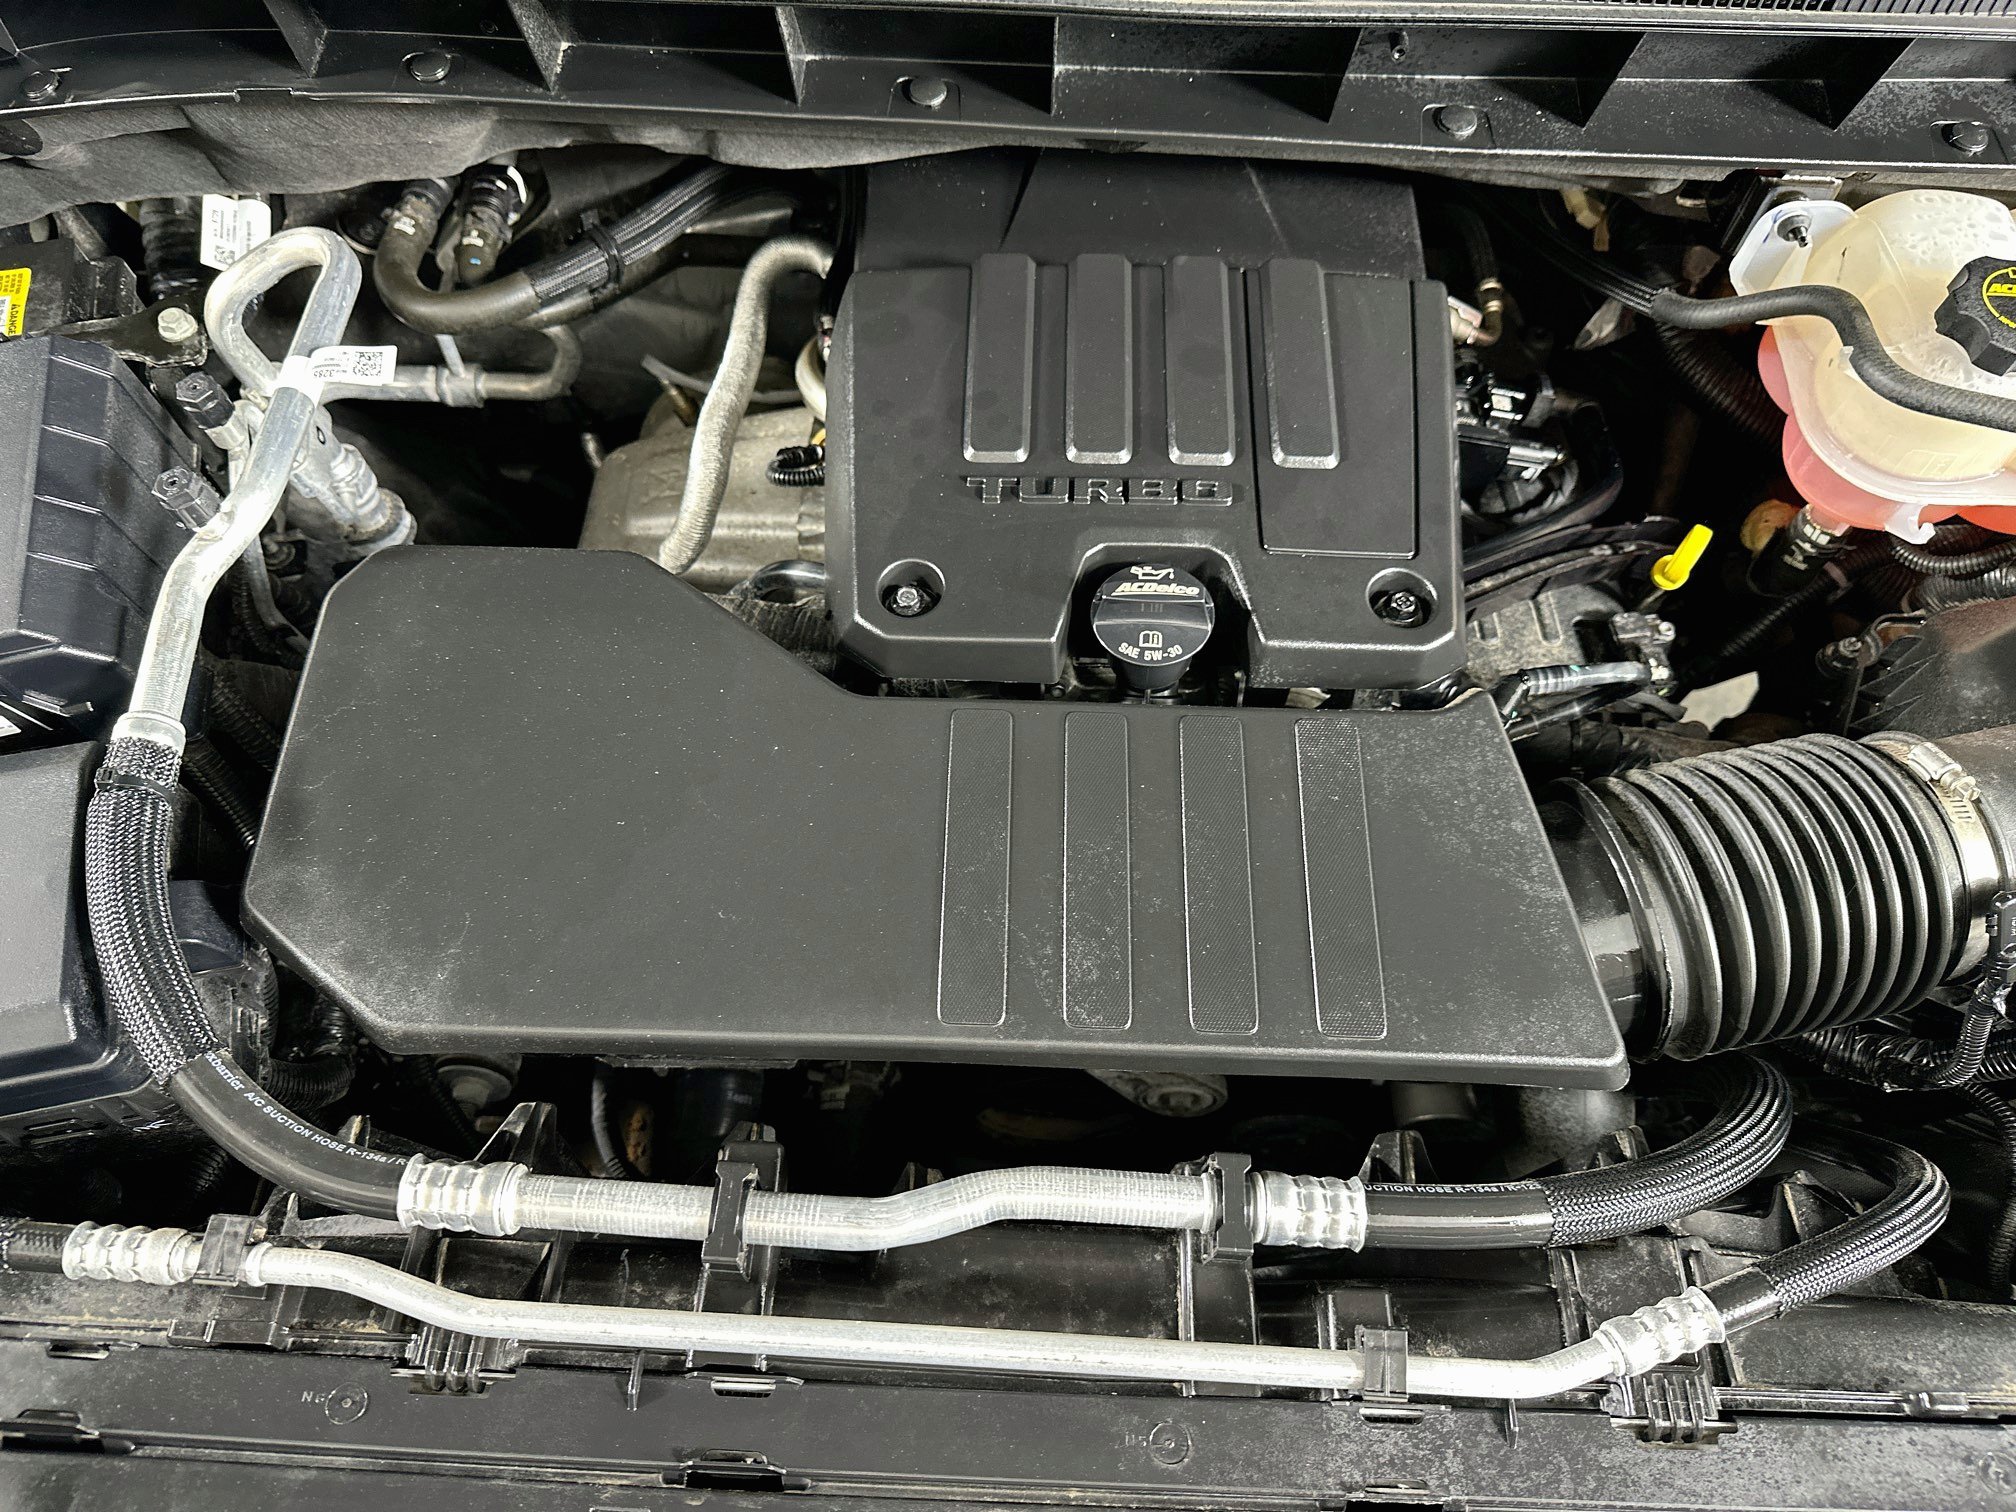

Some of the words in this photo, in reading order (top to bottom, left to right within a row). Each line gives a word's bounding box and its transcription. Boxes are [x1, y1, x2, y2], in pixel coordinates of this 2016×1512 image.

[965, 476, 1233, 505] TURBO
[1112, 582, 1200, 596] ACDelco
[1118, 642, 1141, 659] SAE
[1143, 644, 1183, 661] 5W-30
[243, 1091, 265, 1107] A/C
[262, 1106, 313, 1137] SUCTION
[311, 1134, 347, 1152] HOSE
[345, 1147, 387, 1163] R-134a
[1416, 1185, 1456, 1193] HOSE
